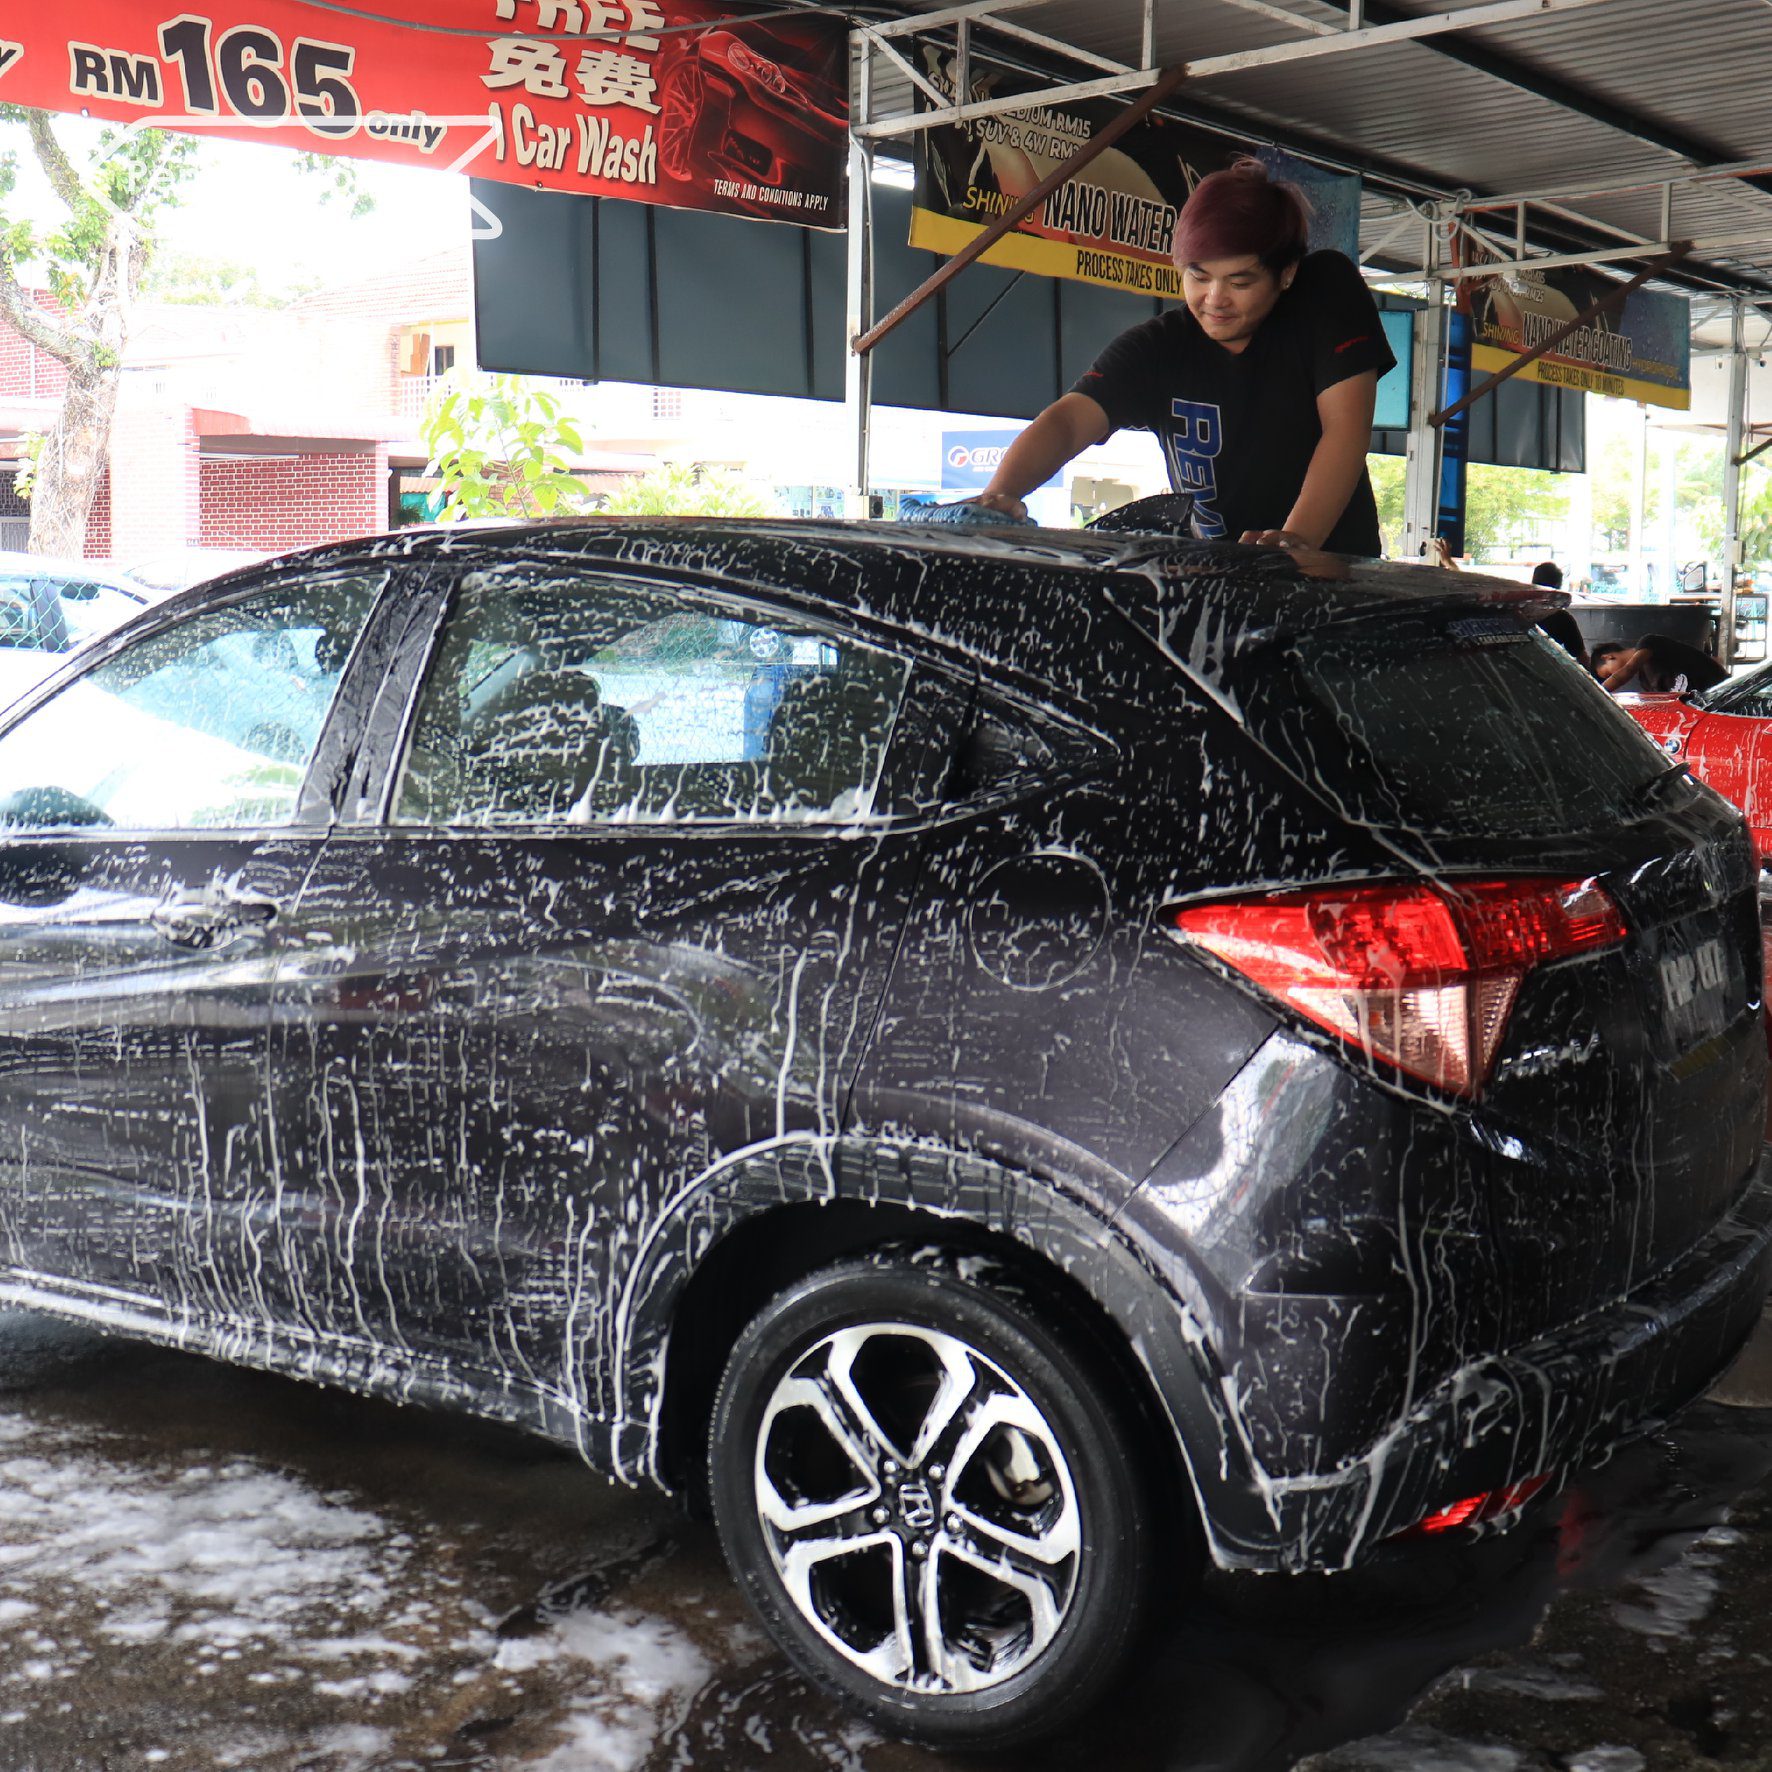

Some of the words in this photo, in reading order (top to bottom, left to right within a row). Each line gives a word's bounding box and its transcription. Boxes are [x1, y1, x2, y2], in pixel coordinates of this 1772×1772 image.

[479, 31, 662, 114] 免費
[364, 109, 448, 154] only
[976, 118, 1010, 144] SUV
[1049, 137, 1080, 160] RM
[1000, 106, 1053, 129] DIUM
[512, 103, 571, 170] Car
[575, 113, 657, 184] Wash
[714, 179, 740, 198] TERMS
[741, 183, 757, 200] AND
[759, 186, 803, 207] CONDITIONS
[804, 193, 828, 211] APPLY
[962, 186, 1035, 224] SHINI
[1042, 178, 1108, 240] NANO
[1110, 190, 1177, 256] WATER
[1076, 249, 1124, 283] PROCESS
[1125, 260, 1153, 291] TAKES
[1155, 267, 1182, 295] ONLY
[1537, 360, 1561, 382] PROCESS
[1591, 327, 1633, 371] COATING
